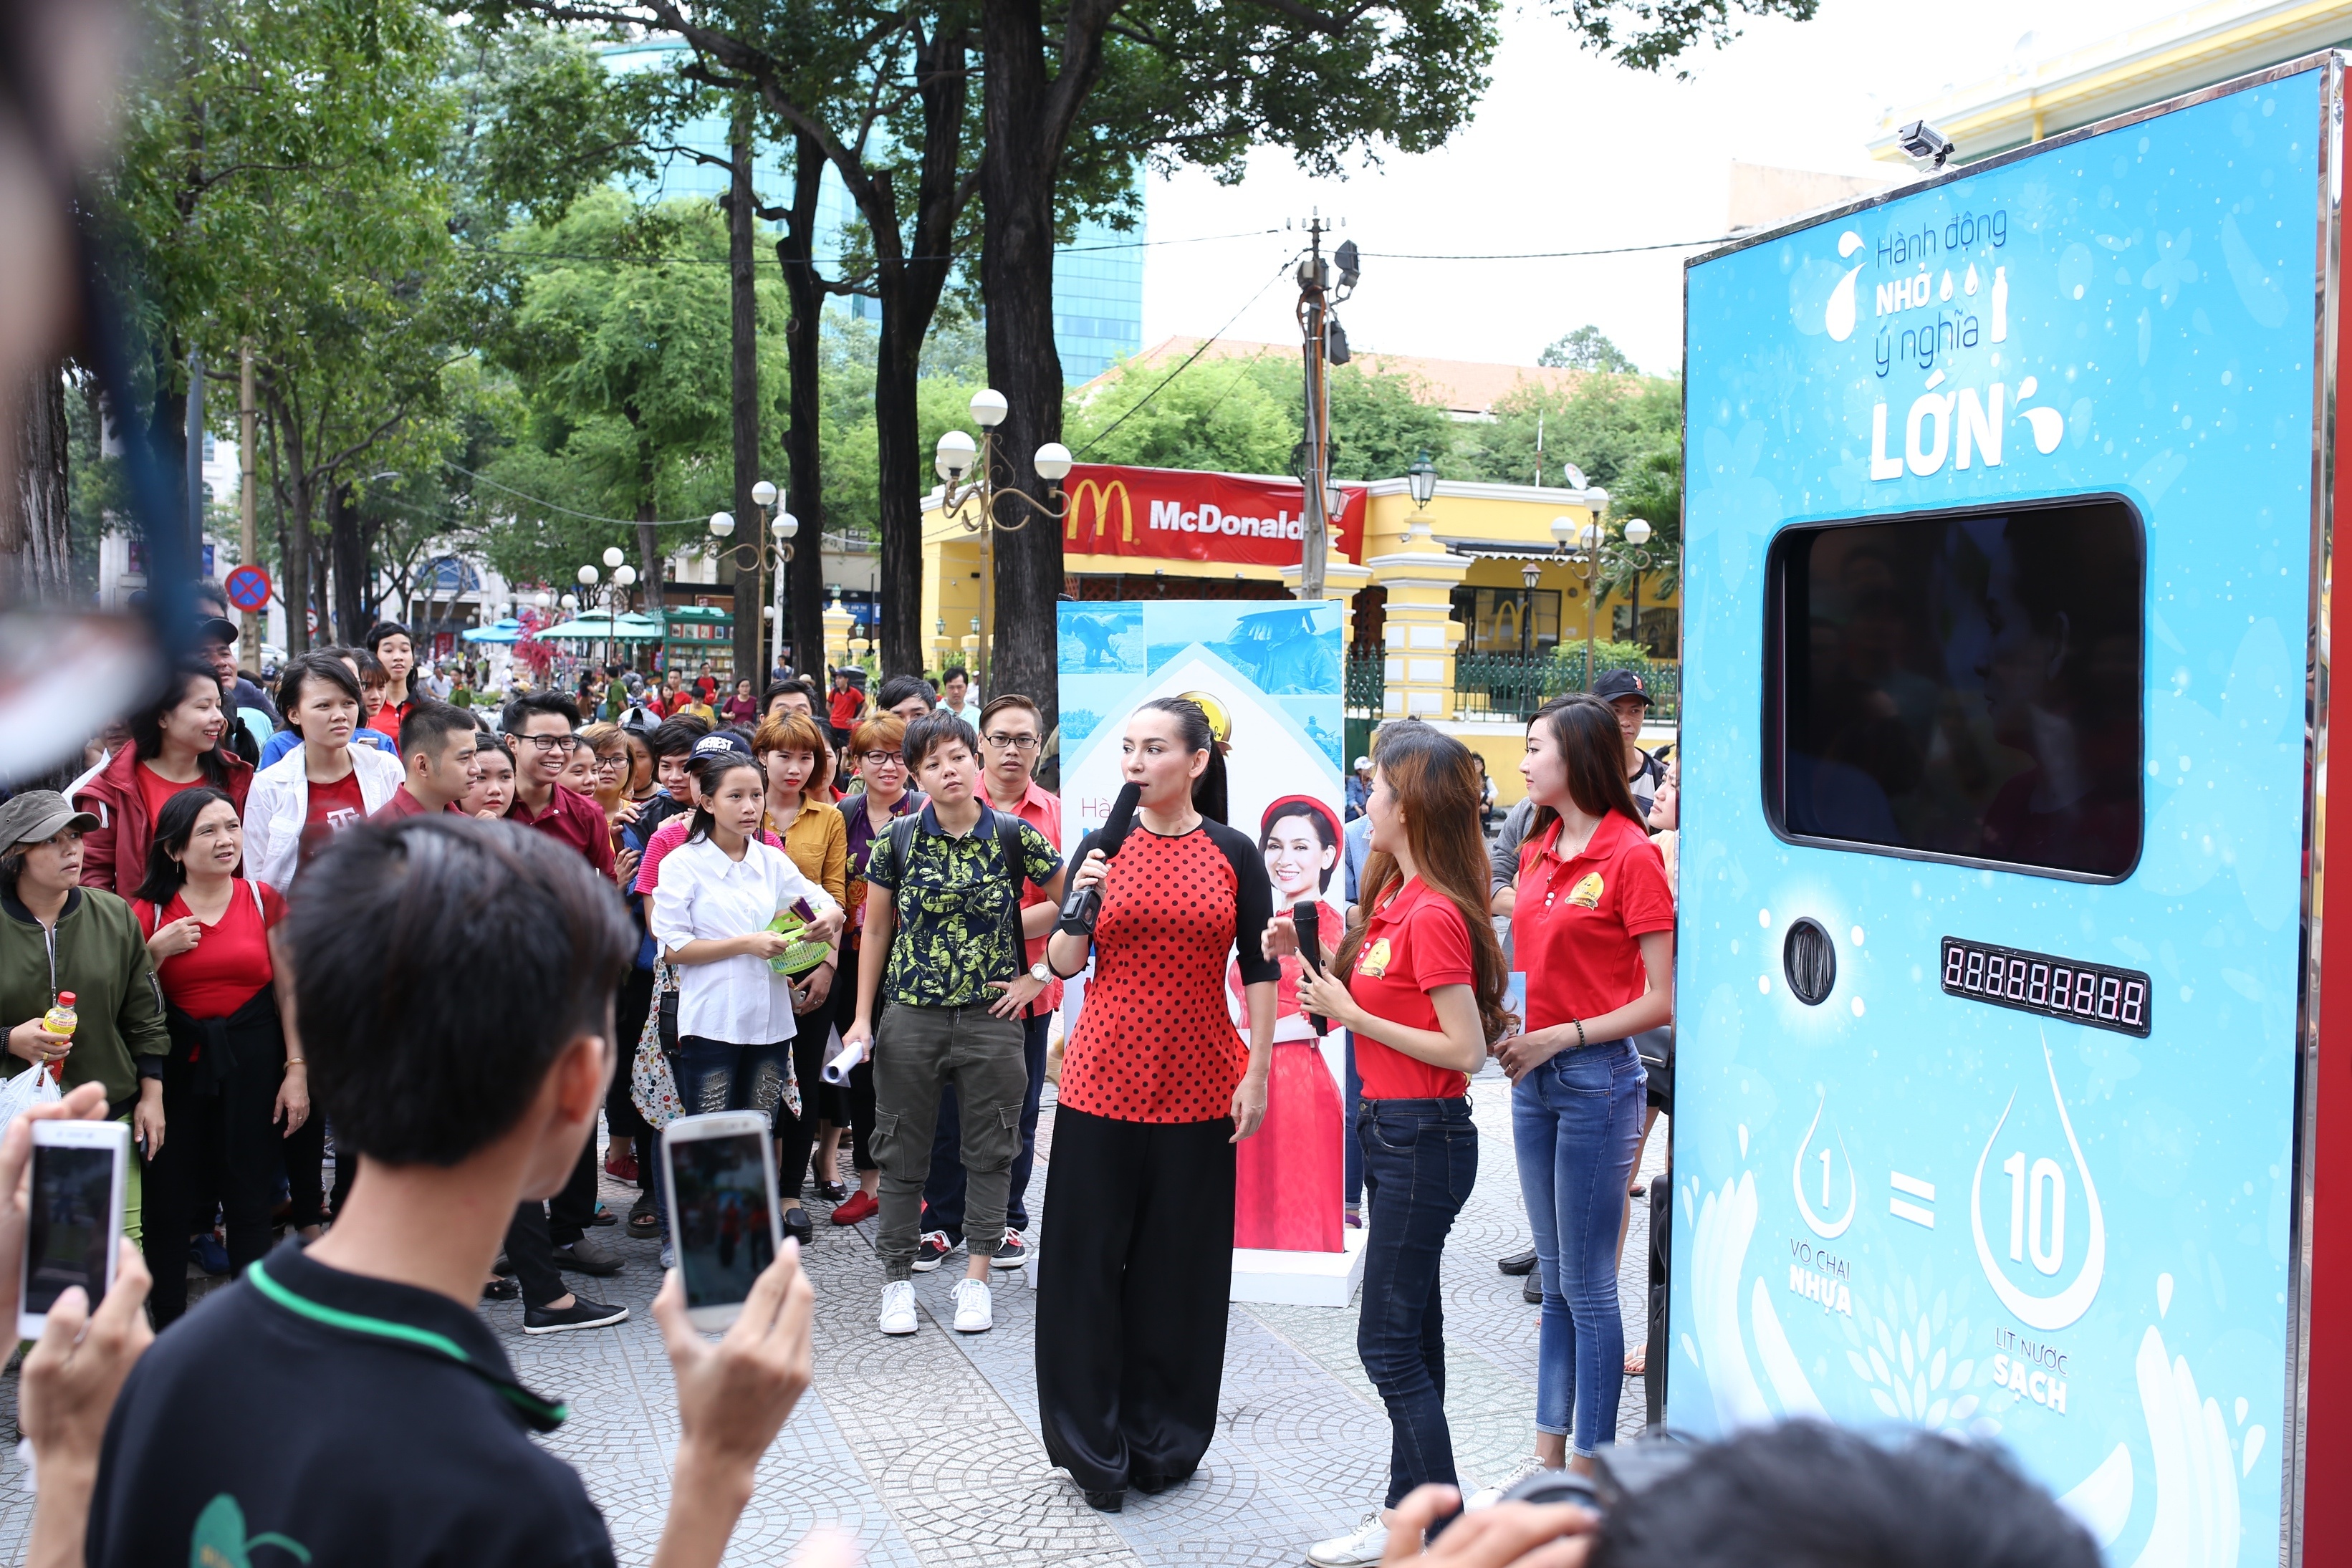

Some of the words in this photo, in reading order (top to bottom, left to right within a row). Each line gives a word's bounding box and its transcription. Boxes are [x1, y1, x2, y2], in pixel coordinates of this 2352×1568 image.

[1877, 222, 1936, 269] Hành
[1944, 209, 2007, 252] động
[1876, 262, 1931, 317] NHỎ
[1876, 324, 1891, 378] ý
[1901, 308, 1979, 370] nghĩa
[1870, 368, 2005, 481] LỚN
[1819, 1148, 1831, 1208] 1
[2003, 1150, 2066, 1276] 10
[1790, 1238, 1812, 1264] VỎ
[1816, 1250, 1850, 1281] CHAI
[1789, 1263, 1853, 1317] NHỰA
[1995, 1327, 2017, 1349] LÍT
[2020, 1337, 2068, 1376] NƯỚC
[1992, 1353, 2068, 1415] SẠCH
